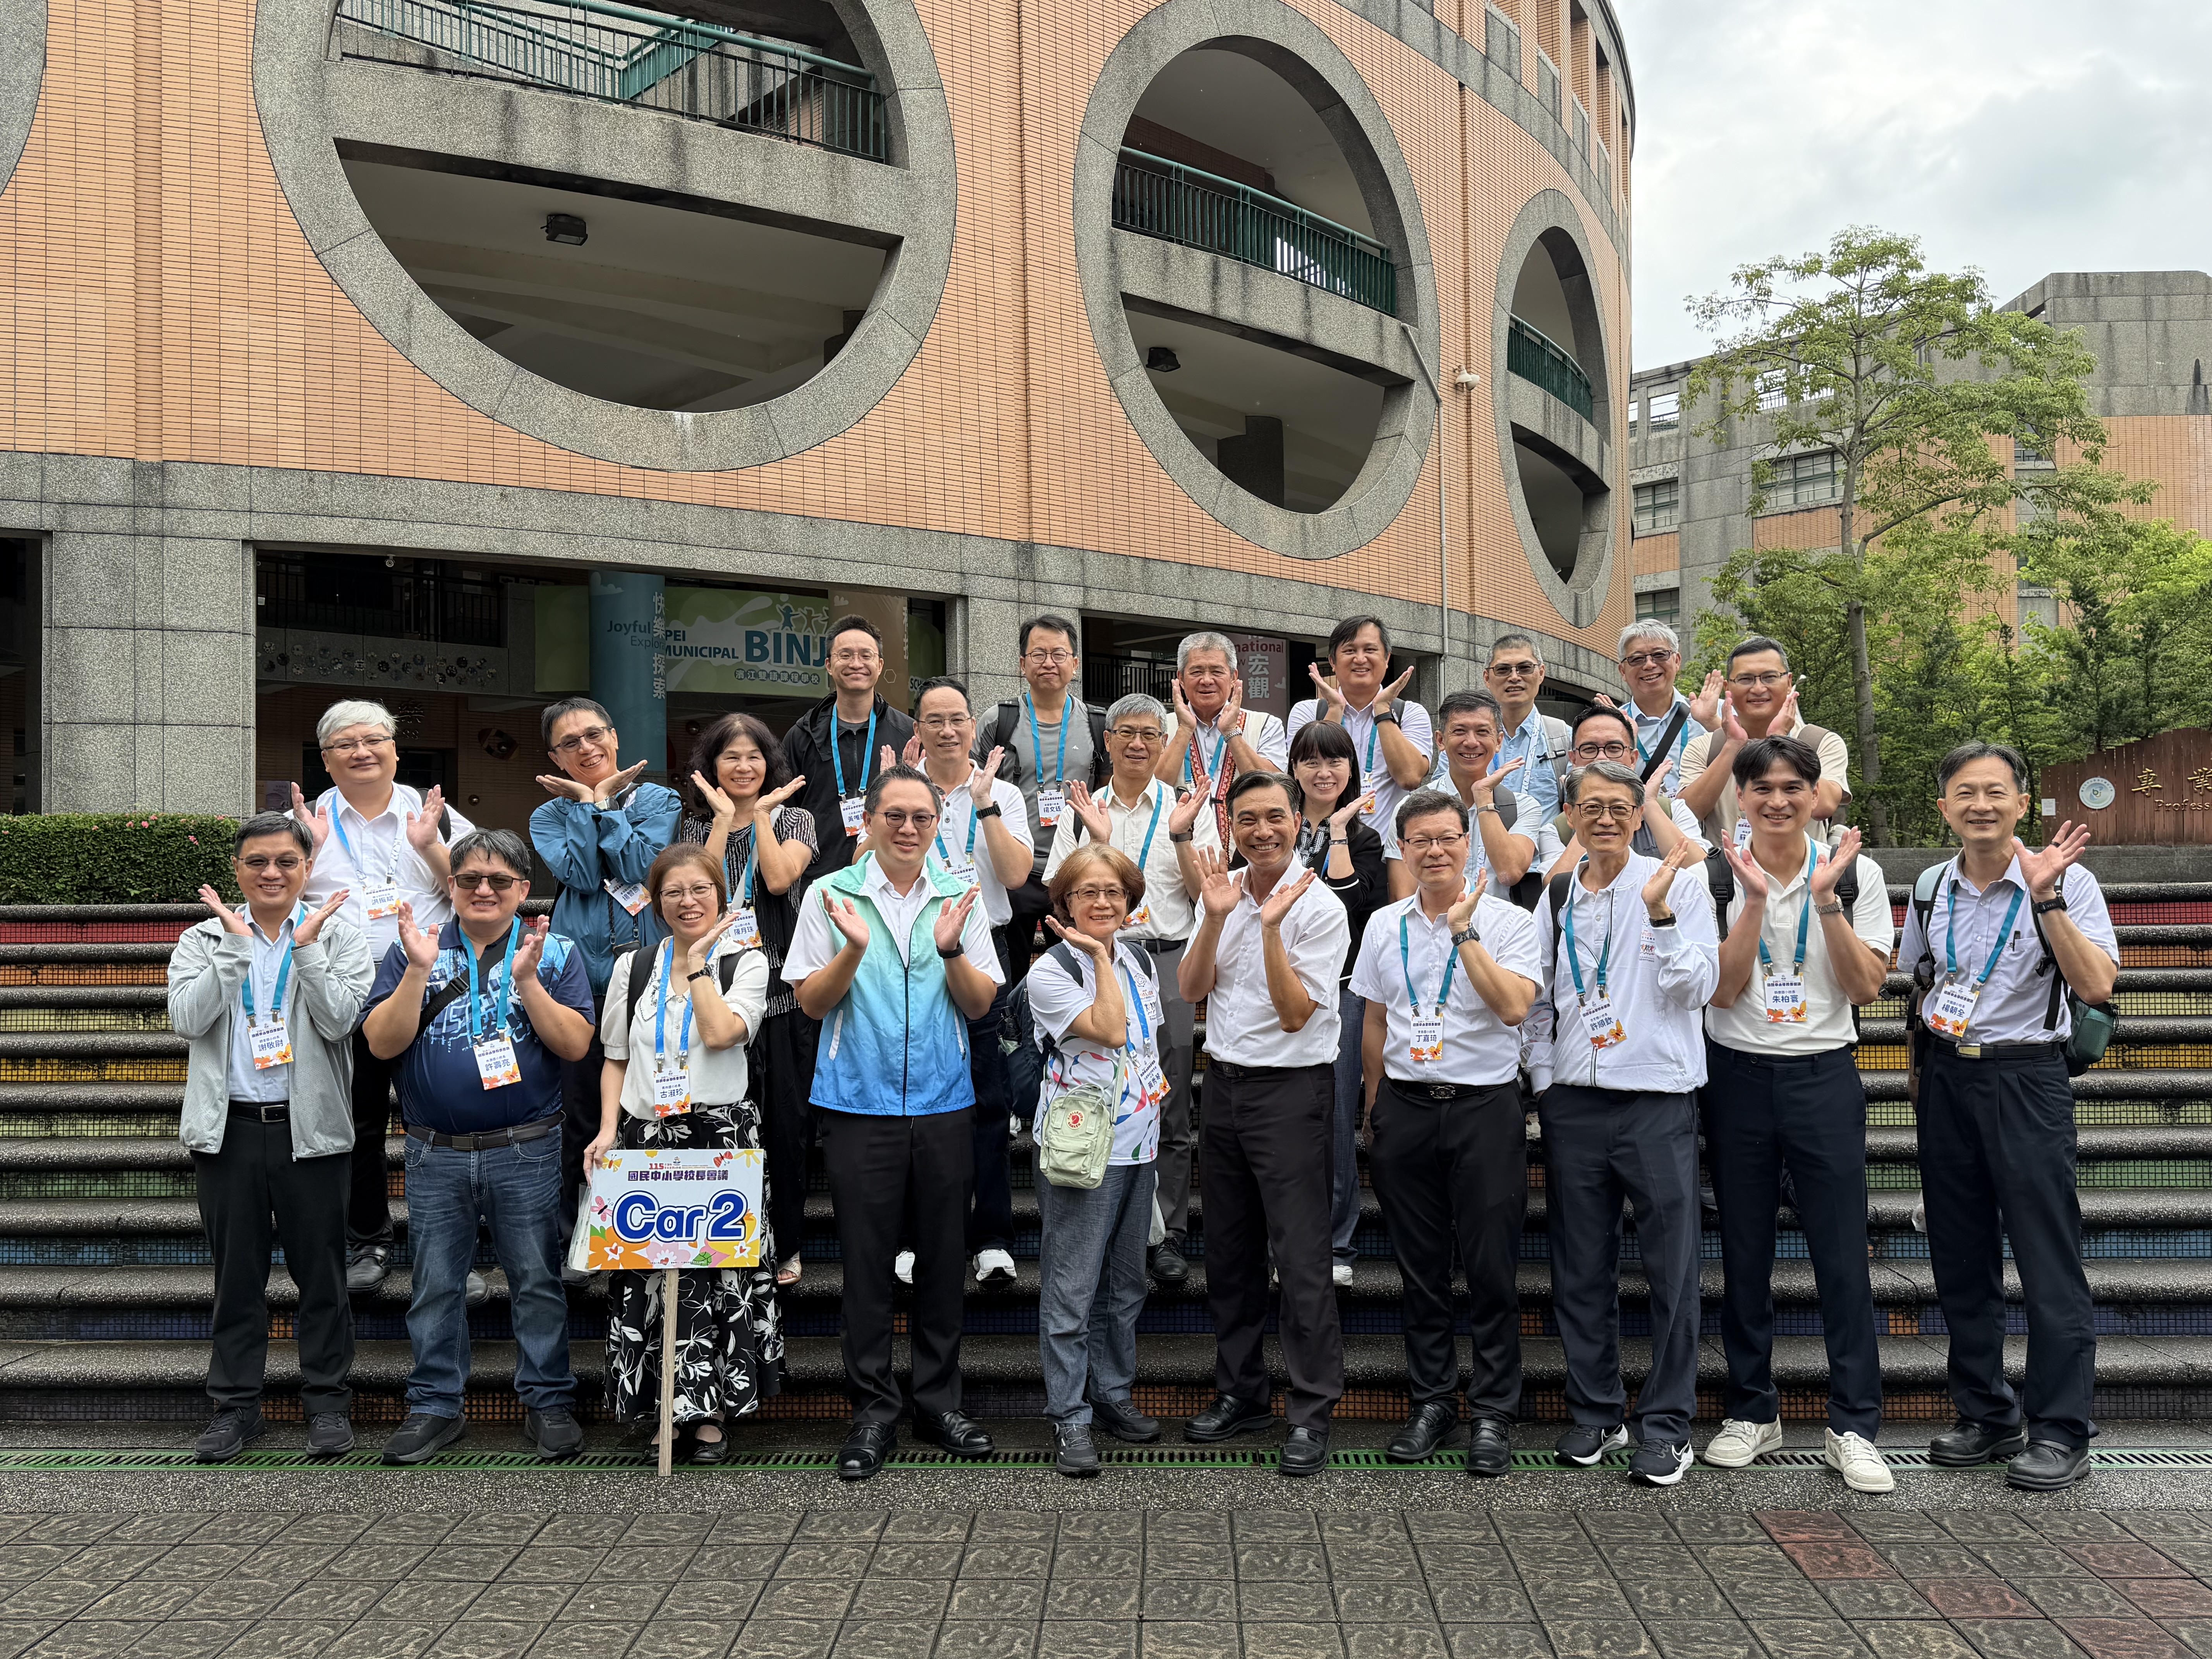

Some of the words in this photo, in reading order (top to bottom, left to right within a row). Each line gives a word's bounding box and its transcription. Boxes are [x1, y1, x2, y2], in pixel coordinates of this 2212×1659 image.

[607, 620, 651, 635] Joyful
[745, 630, 826, 667] BINJ
[1235, 640, 1283, 653] national
[2154, 799, 2212, 811] Profess
[628, 1170, 728, 1181] 國民中小學校長會議
